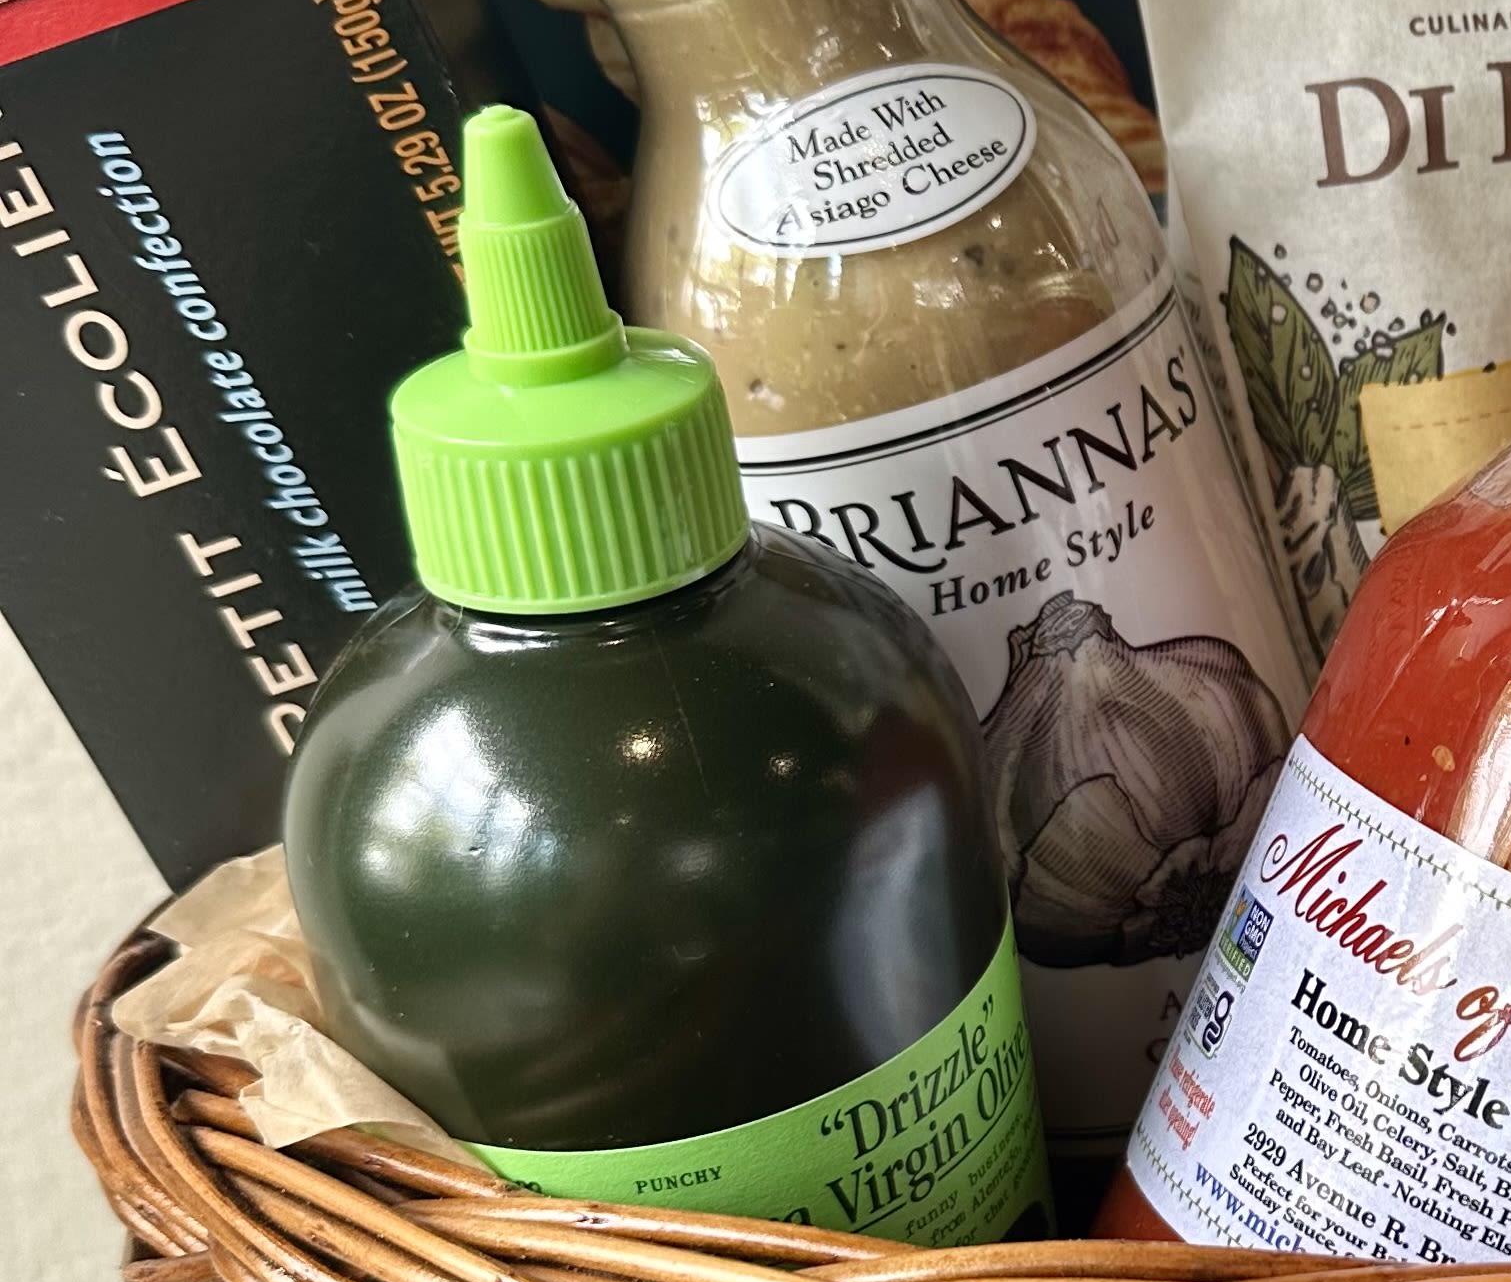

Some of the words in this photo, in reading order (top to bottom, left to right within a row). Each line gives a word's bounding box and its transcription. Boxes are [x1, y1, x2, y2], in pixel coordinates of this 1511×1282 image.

[368, 82, 426, 131] OZ
[787, 120, 872, 164] Made
[872, 91, 947, 132] With
[394, 130, 461, 202] 5.29
[776, 190, 890, 236] Asiago
[902, 139, 1008, 195] Cheese
[813, 122, 954, 191] Shredded
[88, 130, 228, 342] confection
[205, 351, 329, 527] chocolate
[294, 533, 378, 612] milk
[929, 555, 1052, 616] Home
[1065, 500, 1155, 568] Style
[1244, 919, 1265, 948] GMO
[1249, 904, 1271, 933] NON
[1289, 1025, 1360, 1091] Tomatoes,
[1365, 1081, 1434, 1135] Onions,
[1291, 968, 1391, 1065] Home
[1399, 1043, 1510, 1130] Style
[826, 1112, 972, 1224] Virgin
[977, 1020, 1027, 1122] Olive
[1269, 1069, 1322, 1123] Pepper,
[1324, 1109, 1374, 1154] Fresh
[1375, 1143, 1428, 1189] Basil,
[1432, 1174, 1494, 1219] Fresh
[1299, 1063, 1337, 1102] Olive
[1341, 1094, 1368, 1127] Oil,
[1373, 1114, 1438, 1166] Celery,
[1443, 1153, 1488, 1191] Salt,
[635, 1166, 722, 1195] PUNCHY
[905, 1190, 958, 1238] funny
[1229, 1163, 1282, 1214] Sunday
[1283, 1206, 1338, 1256] Sauce,
[1242, 1154, 1294, 1202] Perfect
[1295, 1194, 1322, 1222] for
[1323, 1217, 1368, 1250] your
[1243, 1122, 1287, 1168] 2929
[1286, 1158, 1376, 1229] Avenue
[1380, 1214, 1409, 1249] R.
[1276, 1108, 1303, 1136] and
[1304, 1128, 1339, 1160] Bay
[1340, 1151, 1385, 1186] Leaf
[1392, 1181, 1479, 1241] Nothing
[930, 1208, 967, 1247] from
